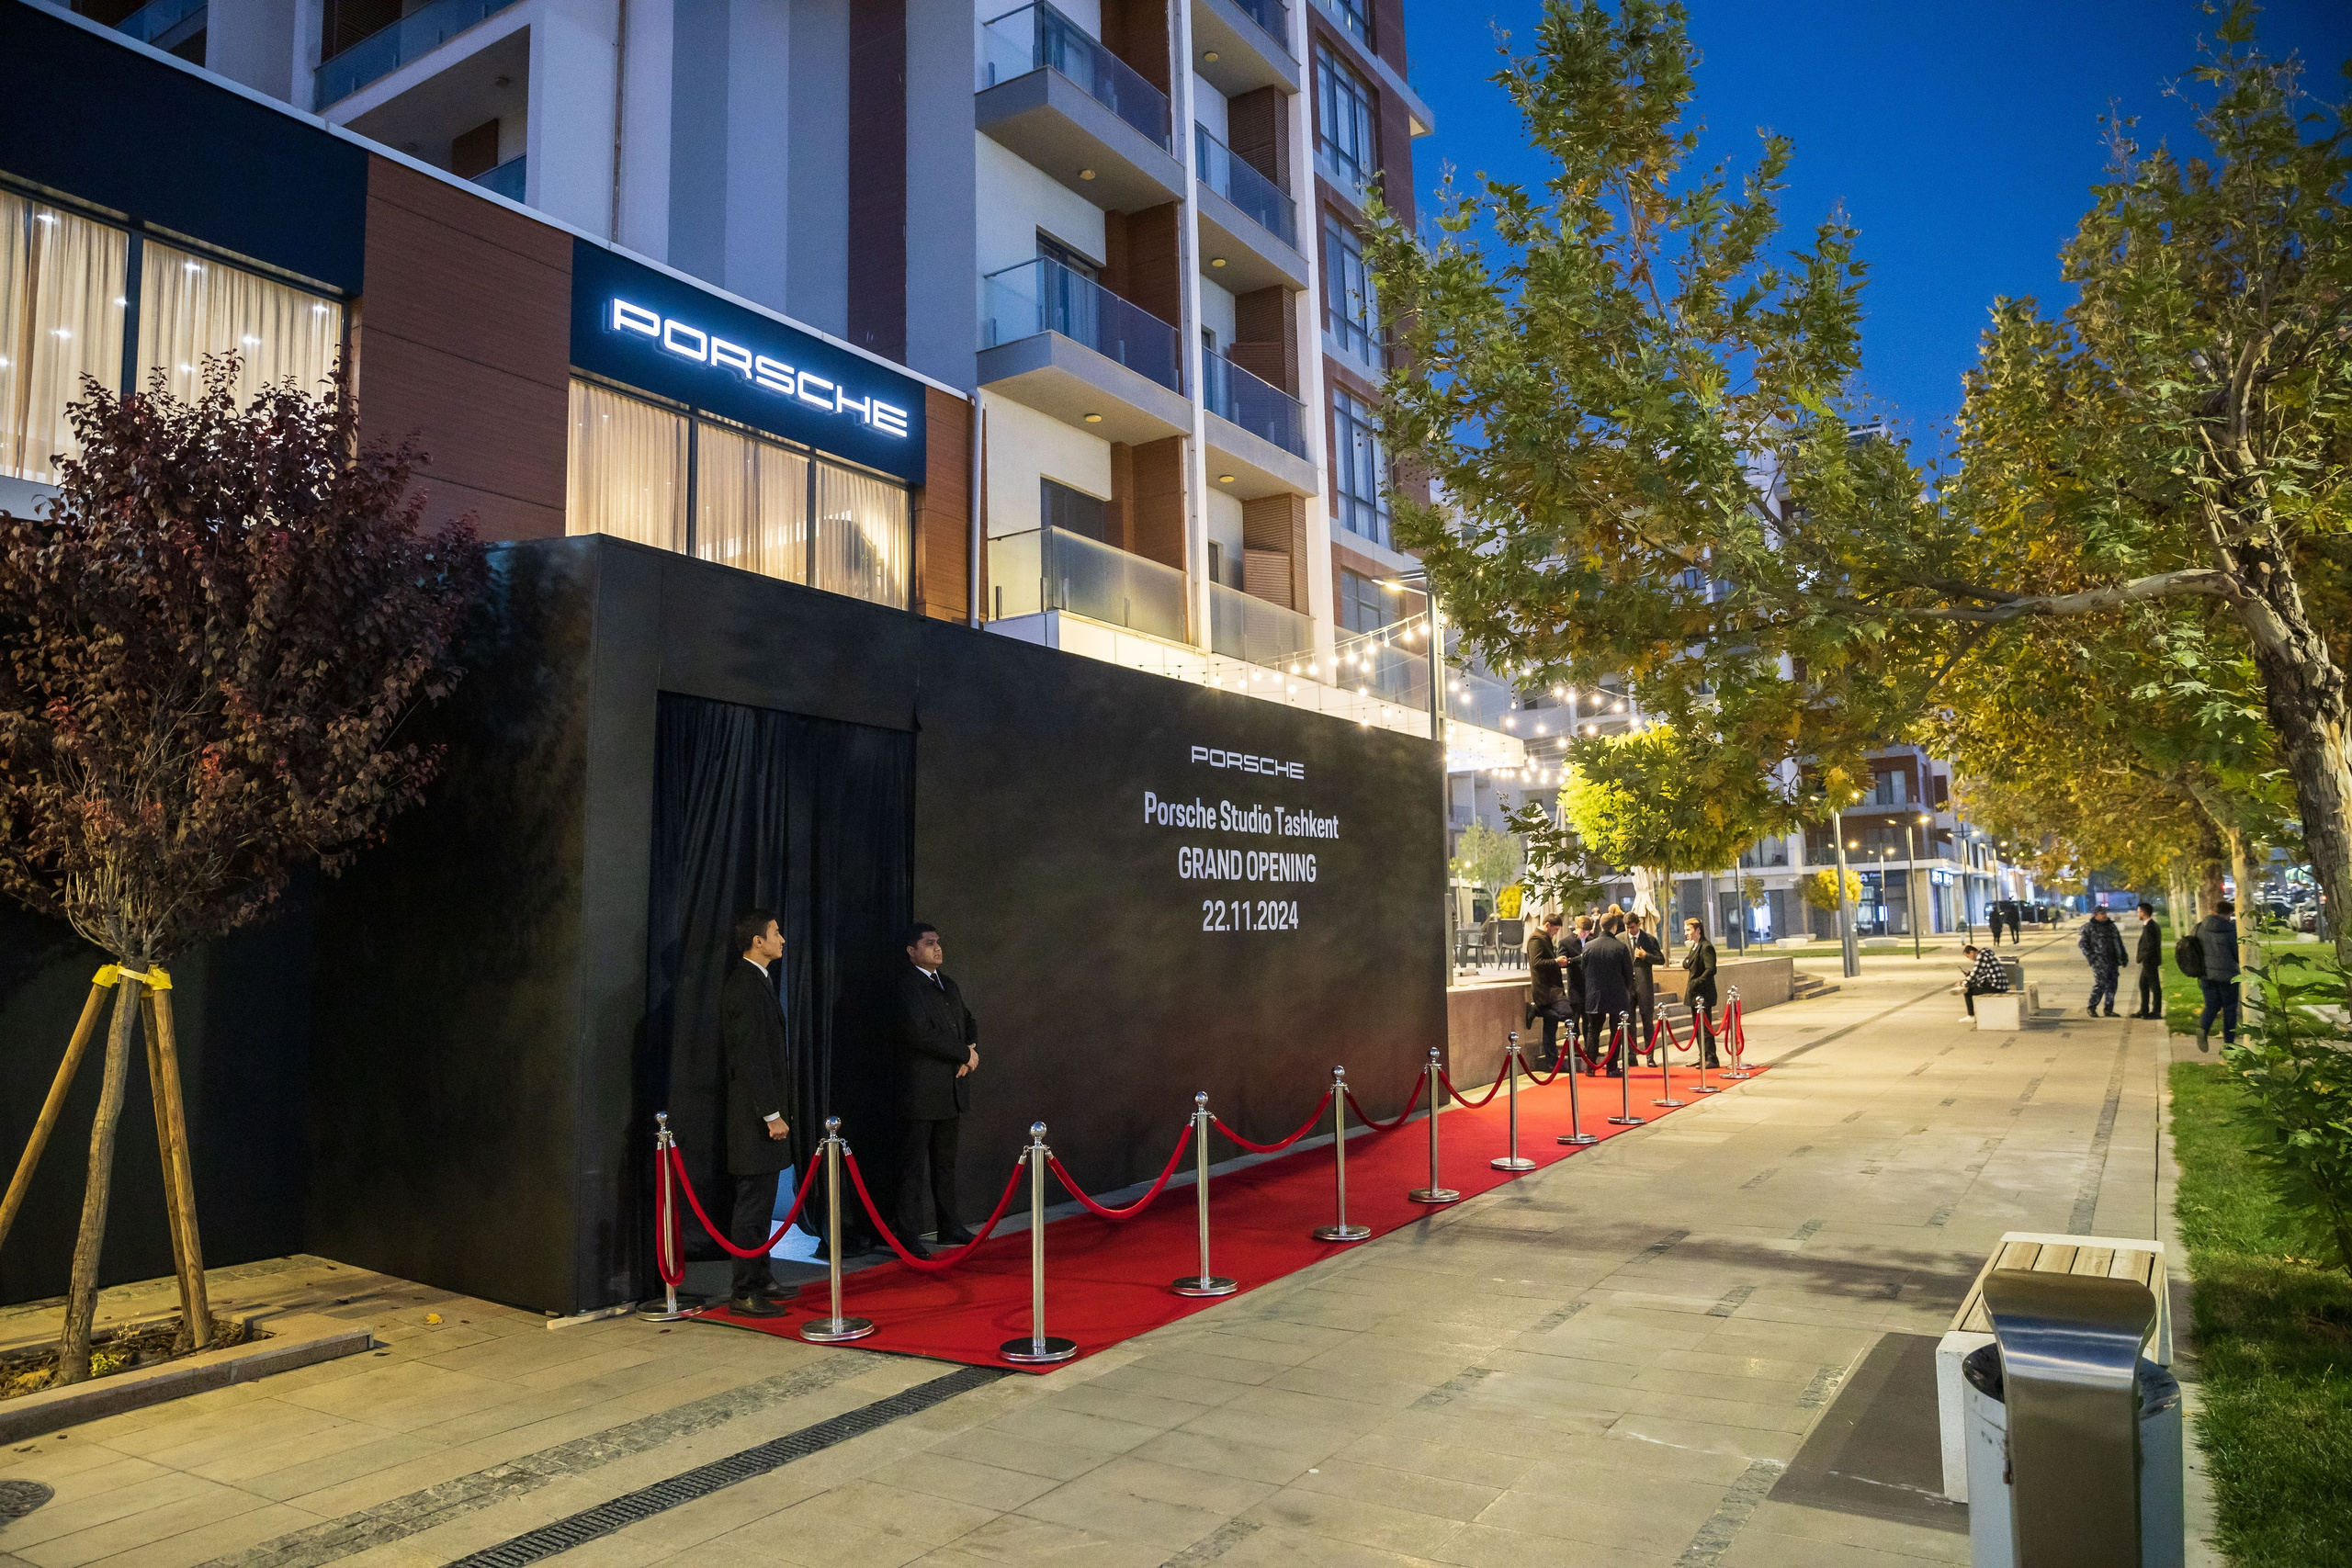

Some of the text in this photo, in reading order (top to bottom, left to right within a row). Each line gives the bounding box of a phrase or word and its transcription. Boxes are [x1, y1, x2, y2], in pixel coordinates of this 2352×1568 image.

[611, 297, 908, 438] PORSCHE
[1191, 745, 1305, 780] PORSCHE
[1144, 791, 1340, 839] Porsche Studio Tashkent
[1178, 846, 1317, 883] GRAND OPENING
[1202, 899, 1299, 931] 22.11.2024
